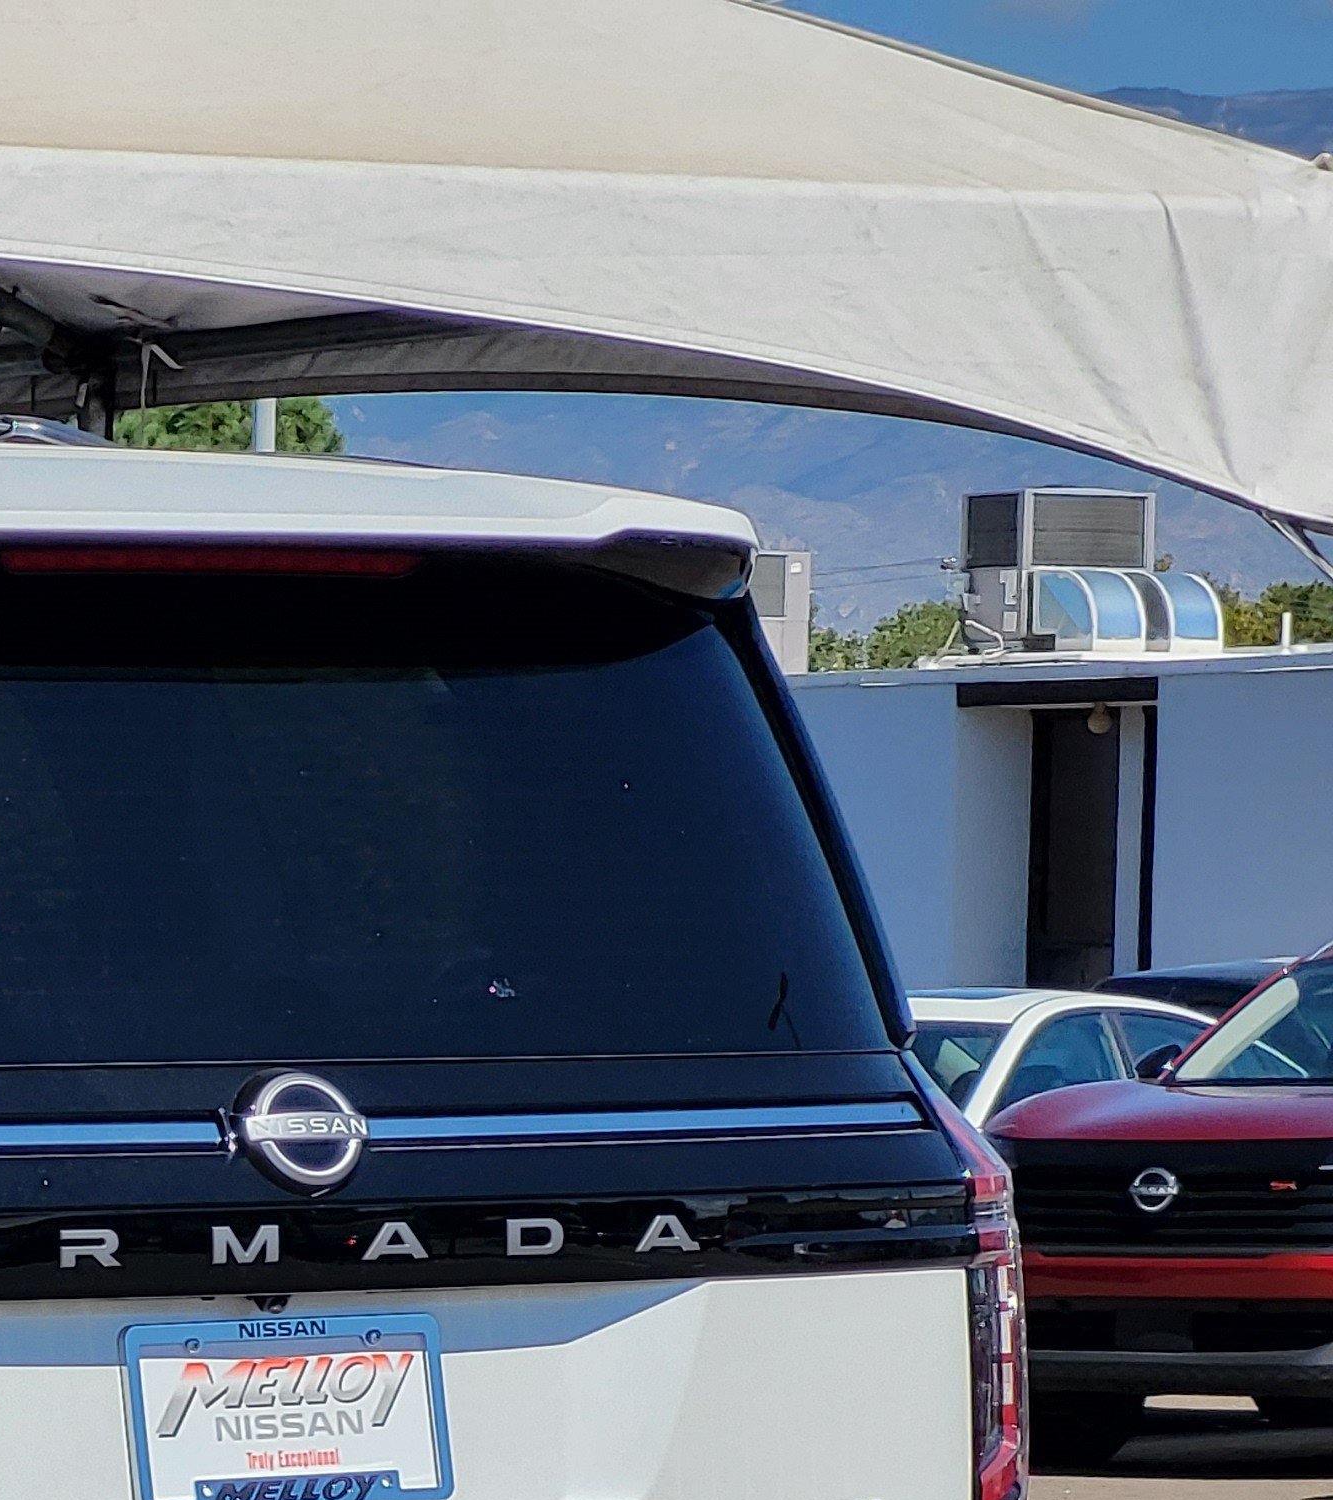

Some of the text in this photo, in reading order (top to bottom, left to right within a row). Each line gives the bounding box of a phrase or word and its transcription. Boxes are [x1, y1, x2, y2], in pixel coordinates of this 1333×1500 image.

[252, 1116, 369, 1138] NISSAN
[238, 1319, 327, 1340] NISSAN
[156, 1353, 414, 1438] MELLOY
[215, 1409, 364, 1443] NISSAN
[245, 1447, 340, 1471] Truly Exceptional
